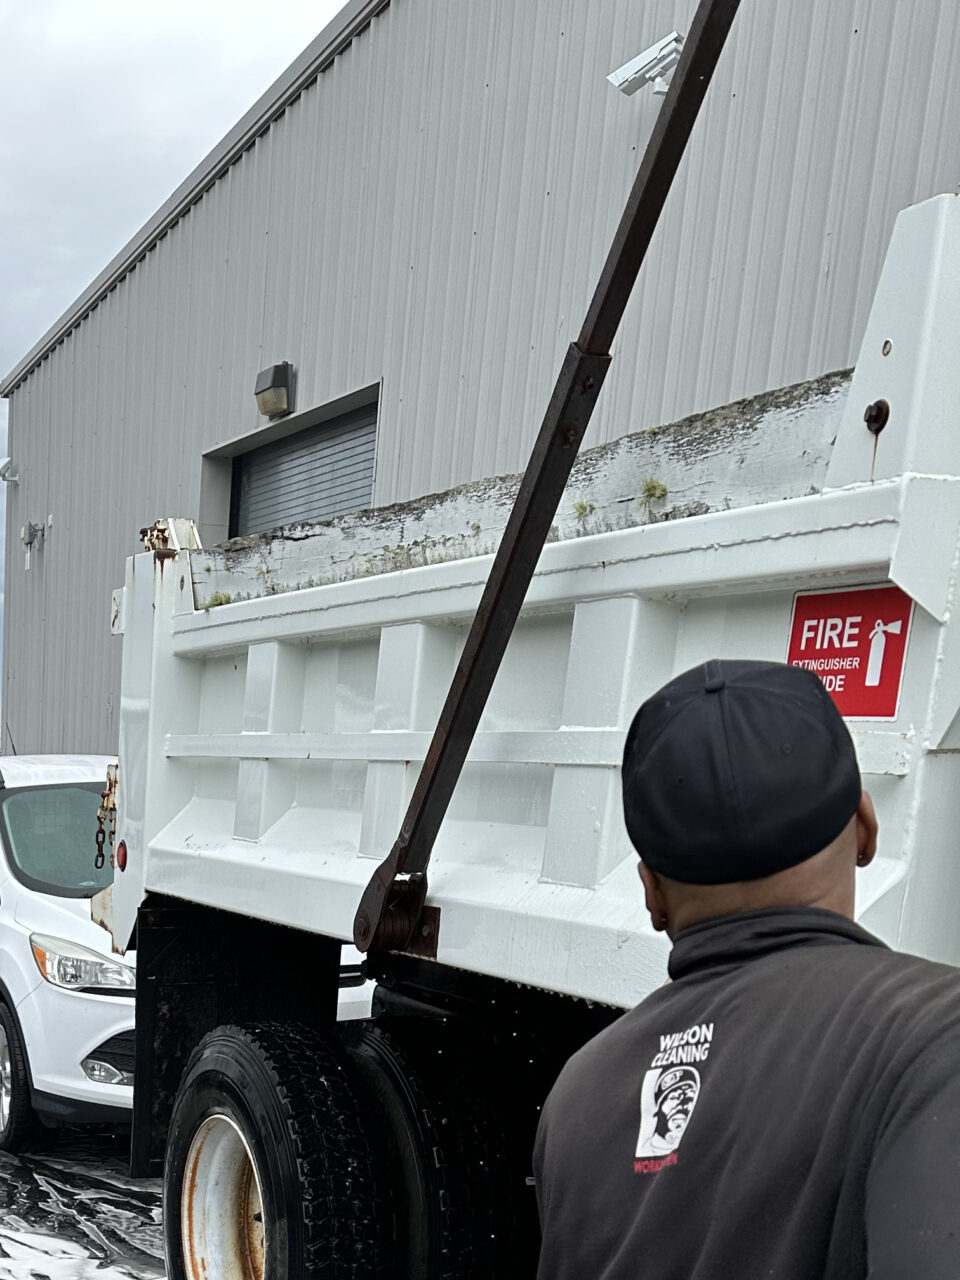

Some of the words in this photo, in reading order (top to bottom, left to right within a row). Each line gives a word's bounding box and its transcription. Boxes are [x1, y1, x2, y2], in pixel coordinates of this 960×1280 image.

[800, 616, 862, 651] FIRE
[792, 657, 861, 671] EXTINGUISHER
[660, 1022, 714, 1051] WILSON
[651, 1043, 710, 1068] CLEANING
